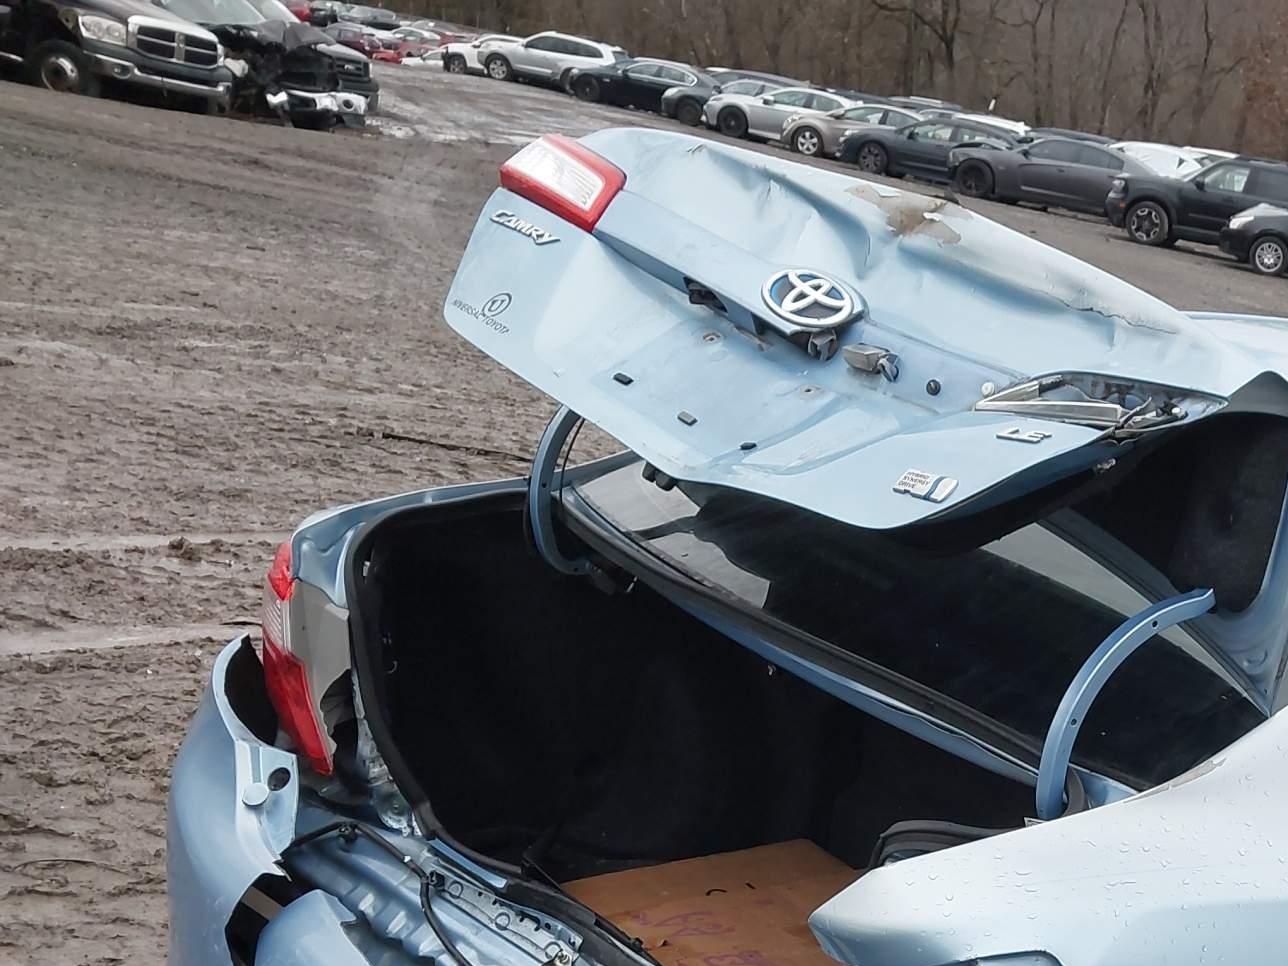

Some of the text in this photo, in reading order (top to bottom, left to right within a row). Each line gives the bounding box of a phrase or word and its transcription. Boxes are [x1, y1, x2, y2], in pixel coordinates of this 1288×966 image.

[490, 209, 560, 245] CAMRY
[483, 314, 510, 334] TOYOTA
[996, 429, 1052, 443] LE
[898, 480, 916, 489] DRIVE
[902, 475, 930, 486] SYNERGY
